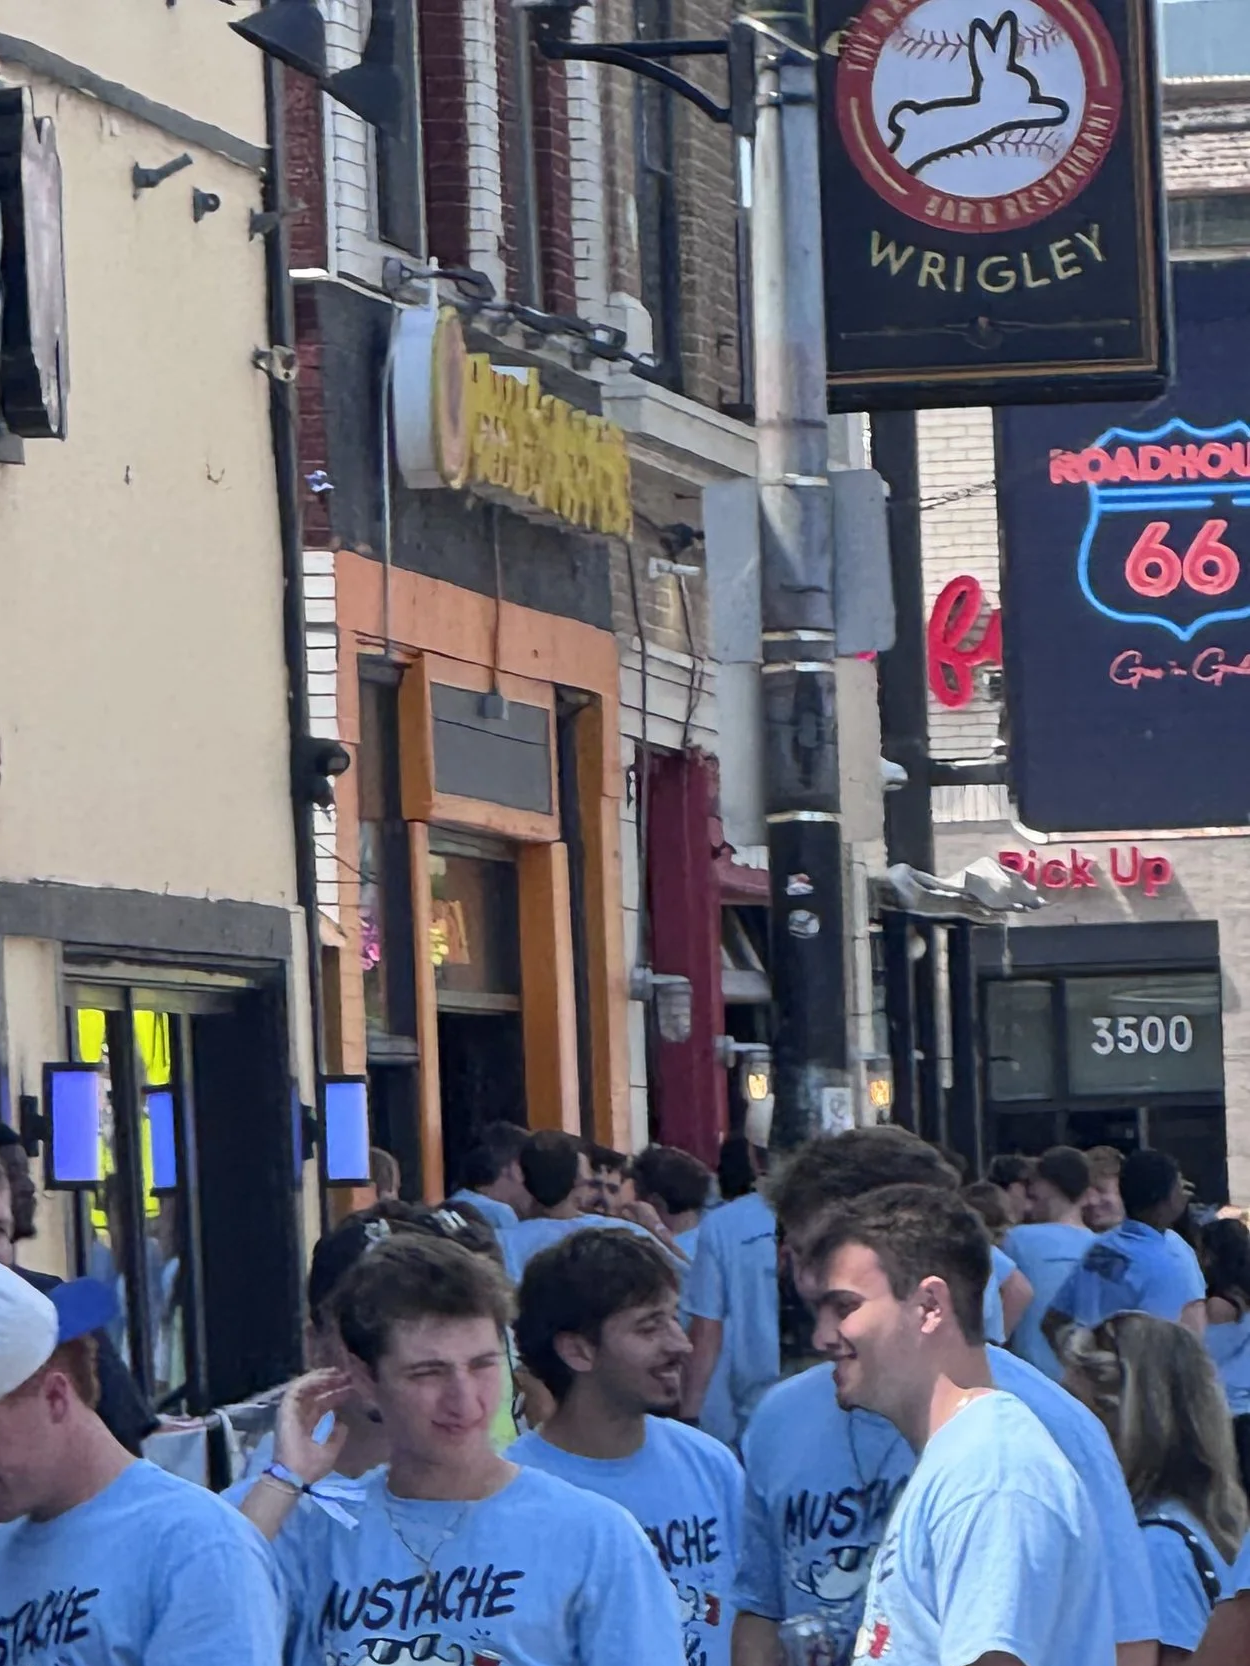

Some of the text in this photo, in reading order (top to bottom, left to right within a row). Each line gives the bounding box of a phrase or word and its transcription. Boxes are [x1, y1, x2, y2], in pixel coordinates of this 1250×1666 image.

[1002, 102, 1113, 221] RESTAURANT
[870, 222, 1107, 293] WRIGLEY
[1124, 518, 1241, 598] 66
[998, 846, 1173, 896] Pick Up
[1091, 1014, 1193, 1056] 3500
[318, 1563, 525, 1645] MUSTACHE
